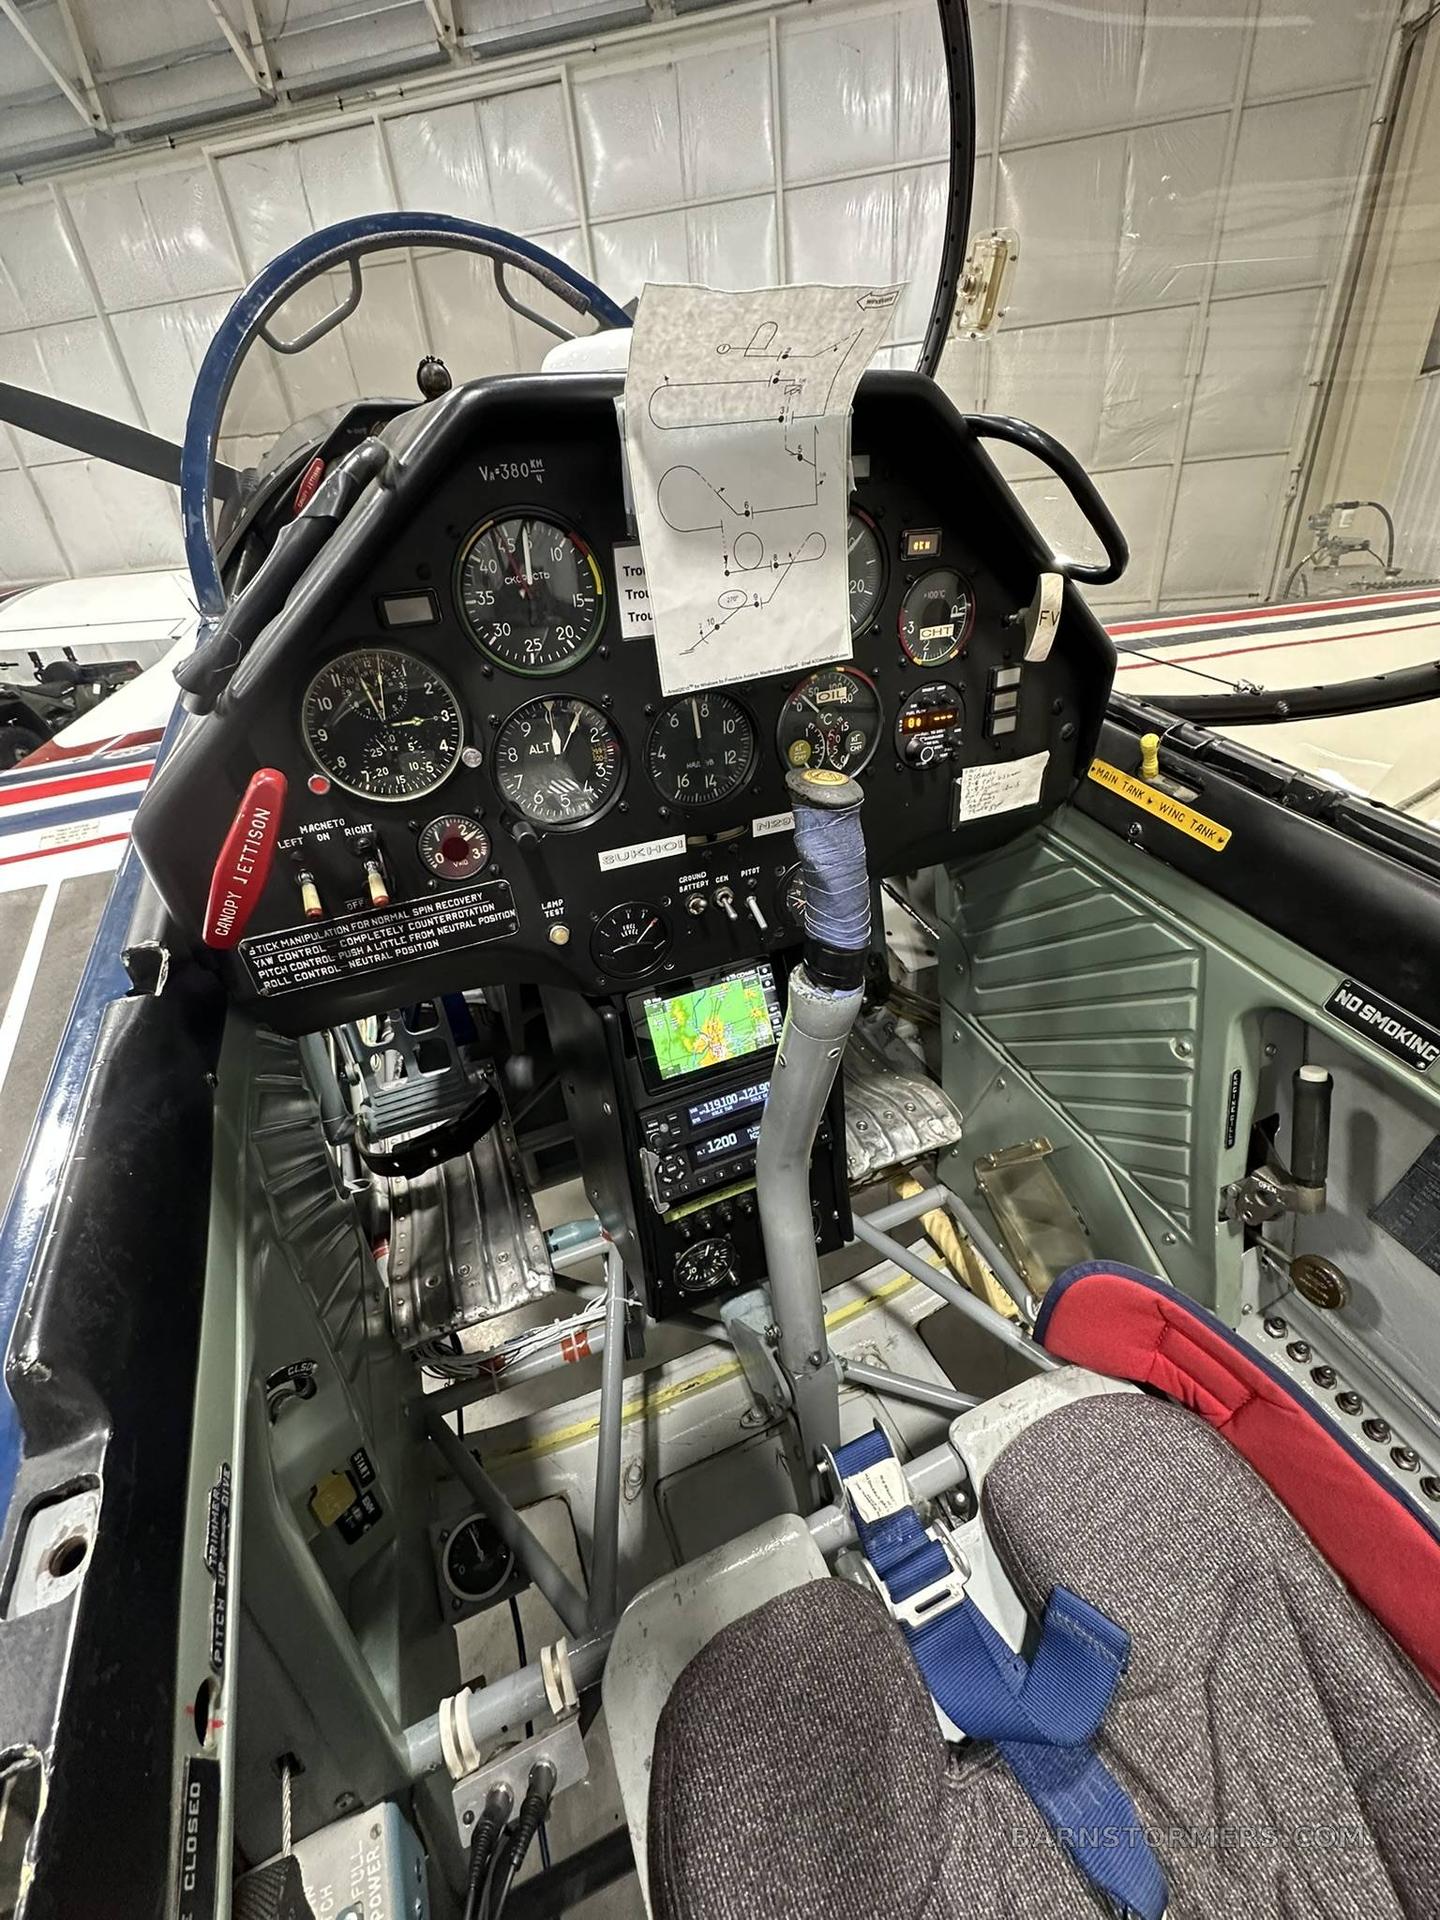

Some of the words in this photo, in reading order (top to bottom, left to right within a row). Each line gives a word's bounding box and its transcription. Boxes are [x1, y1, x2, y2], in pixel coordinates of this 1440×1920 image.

[550, 547, 563, 562] 10
[480, 559, 498, 574] 40
[475, 590, 495, 605] 35
[572, 593, 585, 608] 15
[492, 623, 511, 637] 30
[555, 625, 574, 641] 20
[907, 621, 915, 634] 3
[921, 626, 953, 638] CHT
[524, 638, 543, 652] 25
[923, 640, 930, 651] 2
[424, 682, 434, 695] 2
[818, 690, 846, 701] OIL
[318, 698, 333, 711] 10
[701, 704, 709, 717] 8
[797, 702, 803, 712] 0
[441, 710, 450, 722] 3
[670, 717, 679, 728] 6
[521, 722, 531, 737] 9
[723, 721, 736, 734] 10
[317, 729, 328, 741] 9
[590, 727, 600, 743] 2
[408, 742, 415, 752] 5
[439, 739, 448, 751] 4
[529, 742, 550, 755] ALT
[370, 749, 383, 757] 25
[508, 747, 518, 762] 8
[657, 746, 667, 760] 4
[724, 751, 737, 765] 12
[337, 756, 347, 768] 8
[409, 761, 419, 771] 10
[425, 762, 434, 773] 5
[596, 762, 606, 777] 3
[396, 775, 406, 785] 15
[514, 775, 524, 789] 7
[584, 779, 594, 793] 4
[677, 774, 690, 788] 16
[705, 774, 717, 788] 14
[534, 791, 544, 804] 6
[561, 795, 571, 808] 5
[1096, 767, 1118, 785] MAIN
[1122, 781, 1145, 800] TANK
[1159, 802, 1186, 822] WING
[1190, 818, 1217, 840] TANK
[299, 818, 346, 835] MAGNETO
[344, 823, 374, 837] RIGHT
[458, 824, 468, 836] 2
[277, 836, 303, 850] LEFT
[317, 831, 330, 842] ON
[435, 852, 444, 864] 0
[472, 848, 481, 859] 3
[601, 839, 684, 866] SUKHOI
[214, 891, 242, 937] CANOPY
[236, 808, 271, 885] JETTISON
[678, 871, 707, 883] GROUND
[741, 866, 760, 877] PITOT
[679, 880, 709, 893] BATTERY
[541, 898, 564, 910] LAMP
[544, 906, 566, 919] TEST
[280, 925, 350, 948] MANIPULATION
[350, 919, 370, 932] FOR
[372, 911, 410, 928] NORMAL
[412, 903, 434, 917] SPIN
[435, 892, 483, 911] RECOVERY
[253, 956, 274, 969] YAW
[339, 925, 404, 948] COMPLETELY
[408, 903, 495, 931] COUNTERROTATION
[258, 965, 288, 979] PITCH
[366, 945, 373, 953] A
[374, 935, 407, 951] LITTLE
[409, 929, 435, 942] FROM
[436, 919, 476, 935] NEUTRAL
[478, 909, 516, 925] POSITION
[263, 977, 292, 989] ROLL
[395, 939, 439, 957] POSITION
[1333, 988, 1362, 1013] NO
[1359, 1003, 1440, 1061] SMOKING
[706, 1132, 738, 1153] 1200
[353, 1452, 371, 1479] START
[220, 1469, 230, 1507] DIVE
[208, 1488, 221, 1566] TRIMMER
[218, 1562, 226, 1587] UP
[214, 1598, 226, 1663] PITCH
[184, 1782, 200, 1891] CLOSED
[351, 1840, 363, 1899] FULL
